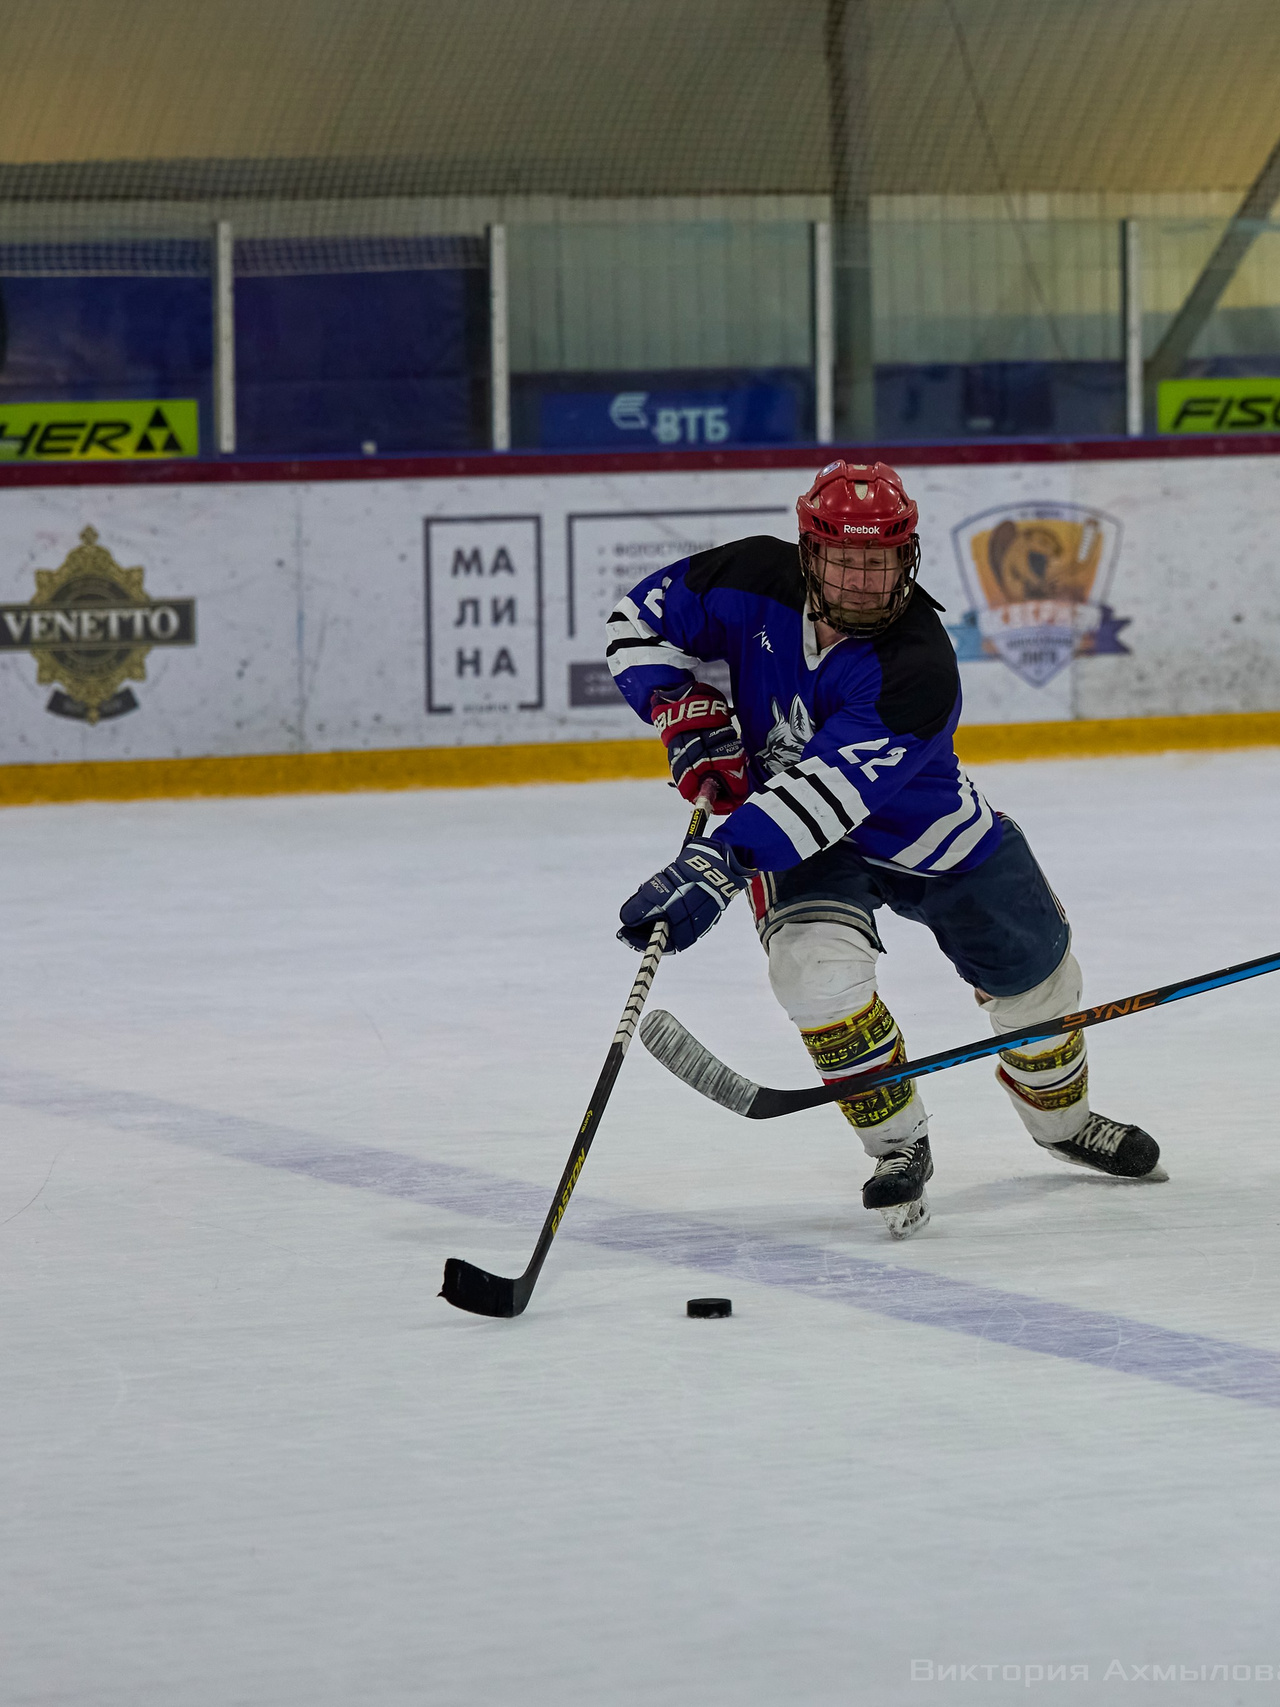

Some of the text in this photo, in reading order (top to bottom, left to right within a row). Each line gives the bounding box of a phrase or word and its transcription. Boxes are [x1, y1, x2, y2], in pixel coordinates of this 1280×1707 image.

[656, 407, 730, 444] ВТБ
[843, 524, 880, 535] Reebok
[3, 605, 181, 643] VENETTO
[1061, 991, 1159, 1029] SYNC
[551, 1146, 586, 1237] EASTON
